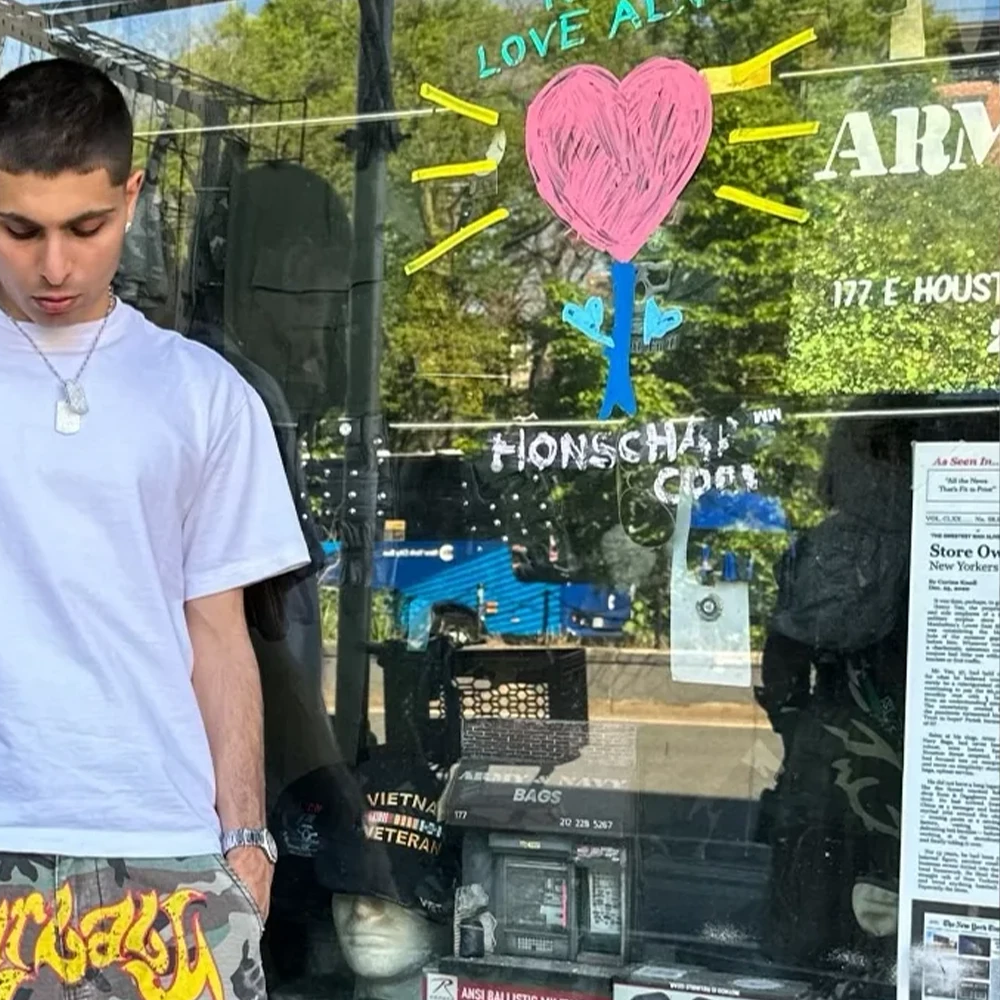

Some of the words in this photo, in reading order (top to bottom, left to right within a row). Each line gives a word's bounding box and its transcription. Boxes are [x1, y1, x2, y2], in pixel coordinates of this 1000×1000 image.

[478, 8, 589, 78] LOVE
[833, 280, 872, 307] 177
[884, 276, 901, 306] E
[933, 457, 947, 466] As
[950, 457, 977, 466] Seen
[930, 544, 973, 558] Store
[929, 561, 955, 571] New
[957, 561, 998, 572] Yorkers
[513, 788, 562, 804] BAGS
[454, 811, 468, 819] 177
[363, 825, 442, 855] VETERAN
[461, 987, 485, 1000] ANSI
